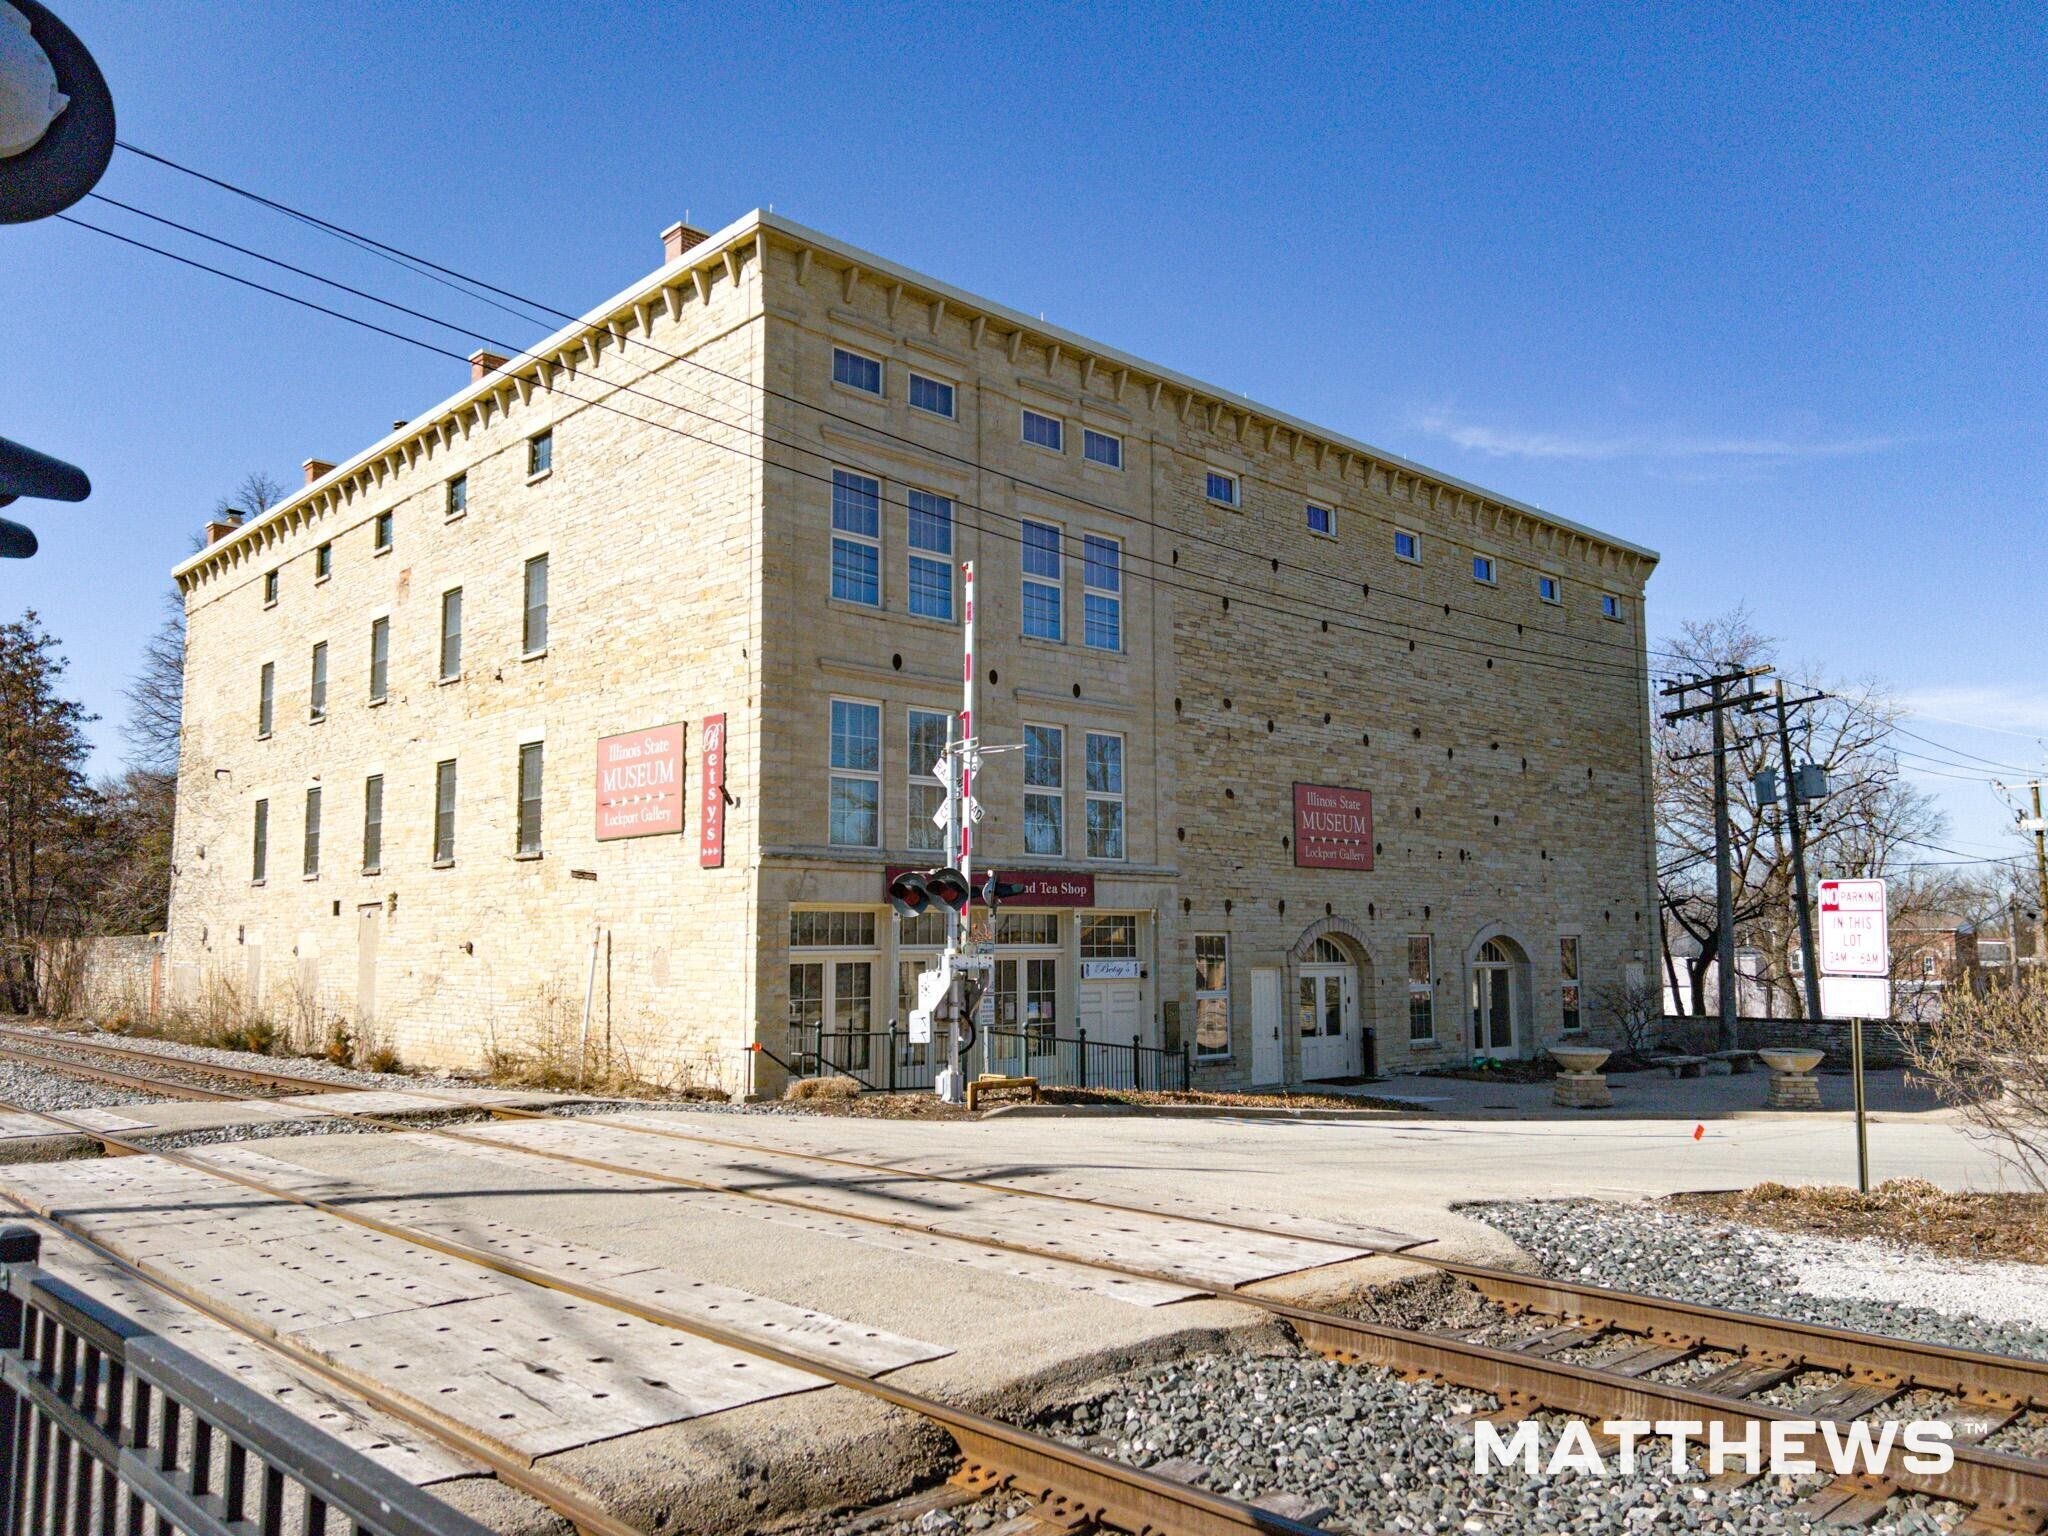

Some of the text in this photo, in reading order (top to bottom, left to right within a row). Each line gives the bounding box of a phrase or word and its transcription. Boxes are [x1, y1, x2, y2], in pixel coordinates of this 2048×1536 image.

[608, 737, 670, 762] Illinois State
[603, 757, 675, 793] MUSEUM
[1307, 791, 1361, 811] Illinois State
[604, 804, 672, 828] Lockport Gallery
[1302, 810, 1366, 835] MUSEUM
[1305, 846, 1365, 863] Lockport Gallery
[1039, 882, 1058, 894] Tea
[1060, 882, 1087, 898] Shop
[1822, 887, 1881, 905] NO PARKING
[1833, 916, 1872, 930] IN THIS
[1843, 934, 1862, 947] LOT
